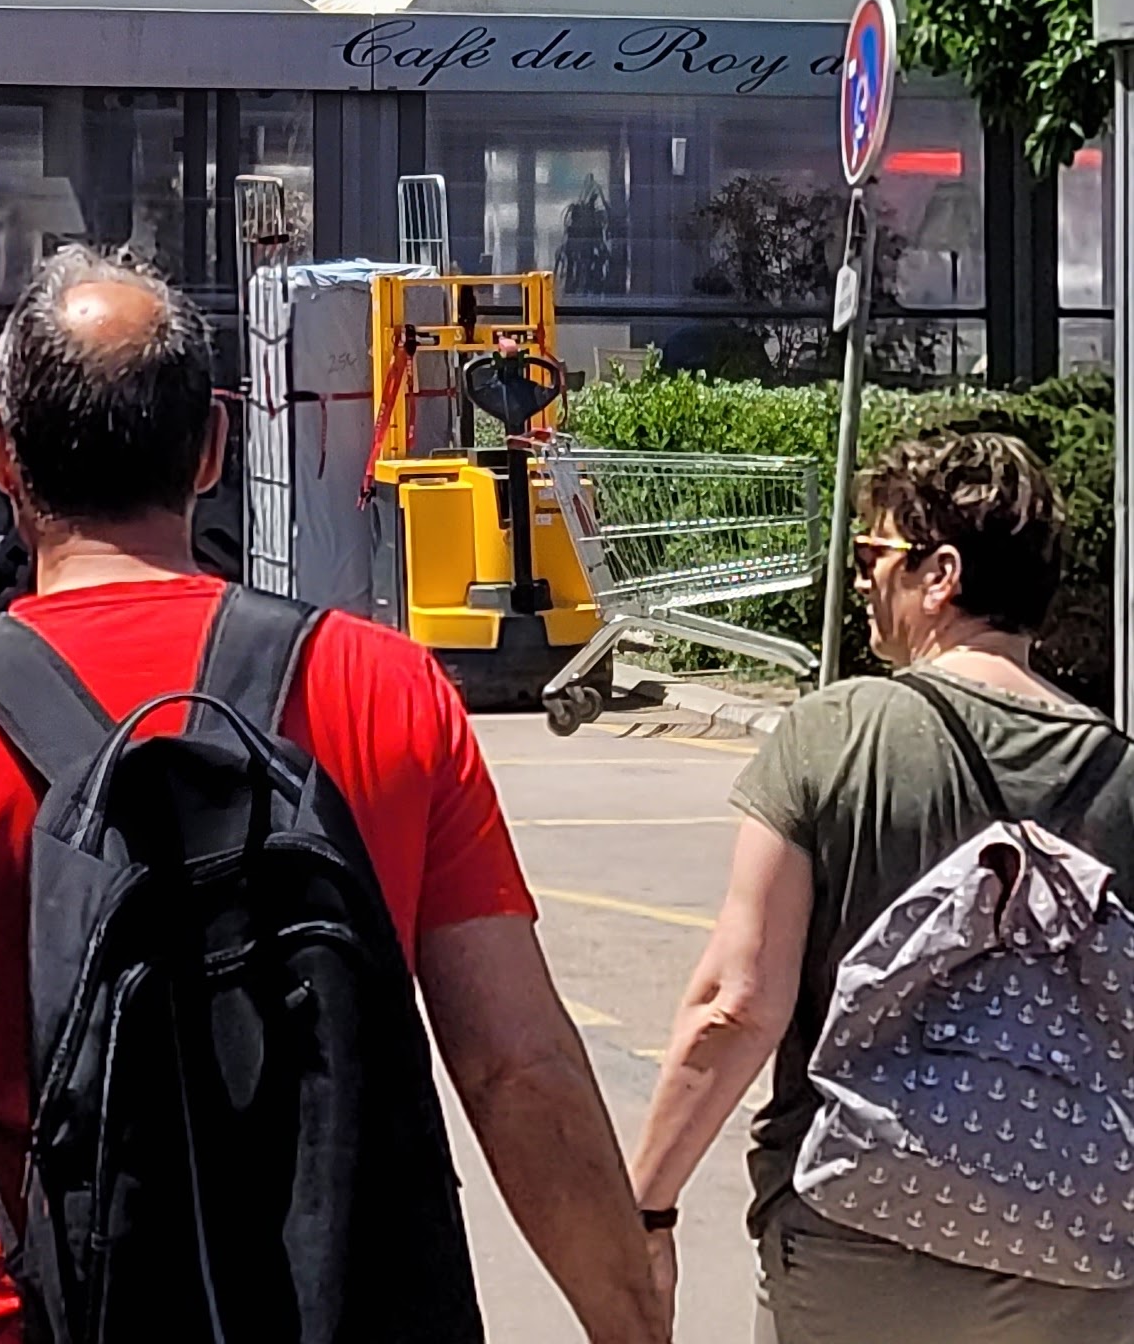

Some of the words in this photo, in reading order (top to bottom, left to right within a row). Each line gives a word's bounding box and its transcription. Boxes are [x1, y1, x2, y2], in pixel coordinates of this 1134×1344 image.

[333, 20, 496, 87] Café
[511, 28, 596, 70] du
[614, 25, 790, 94] Roy
